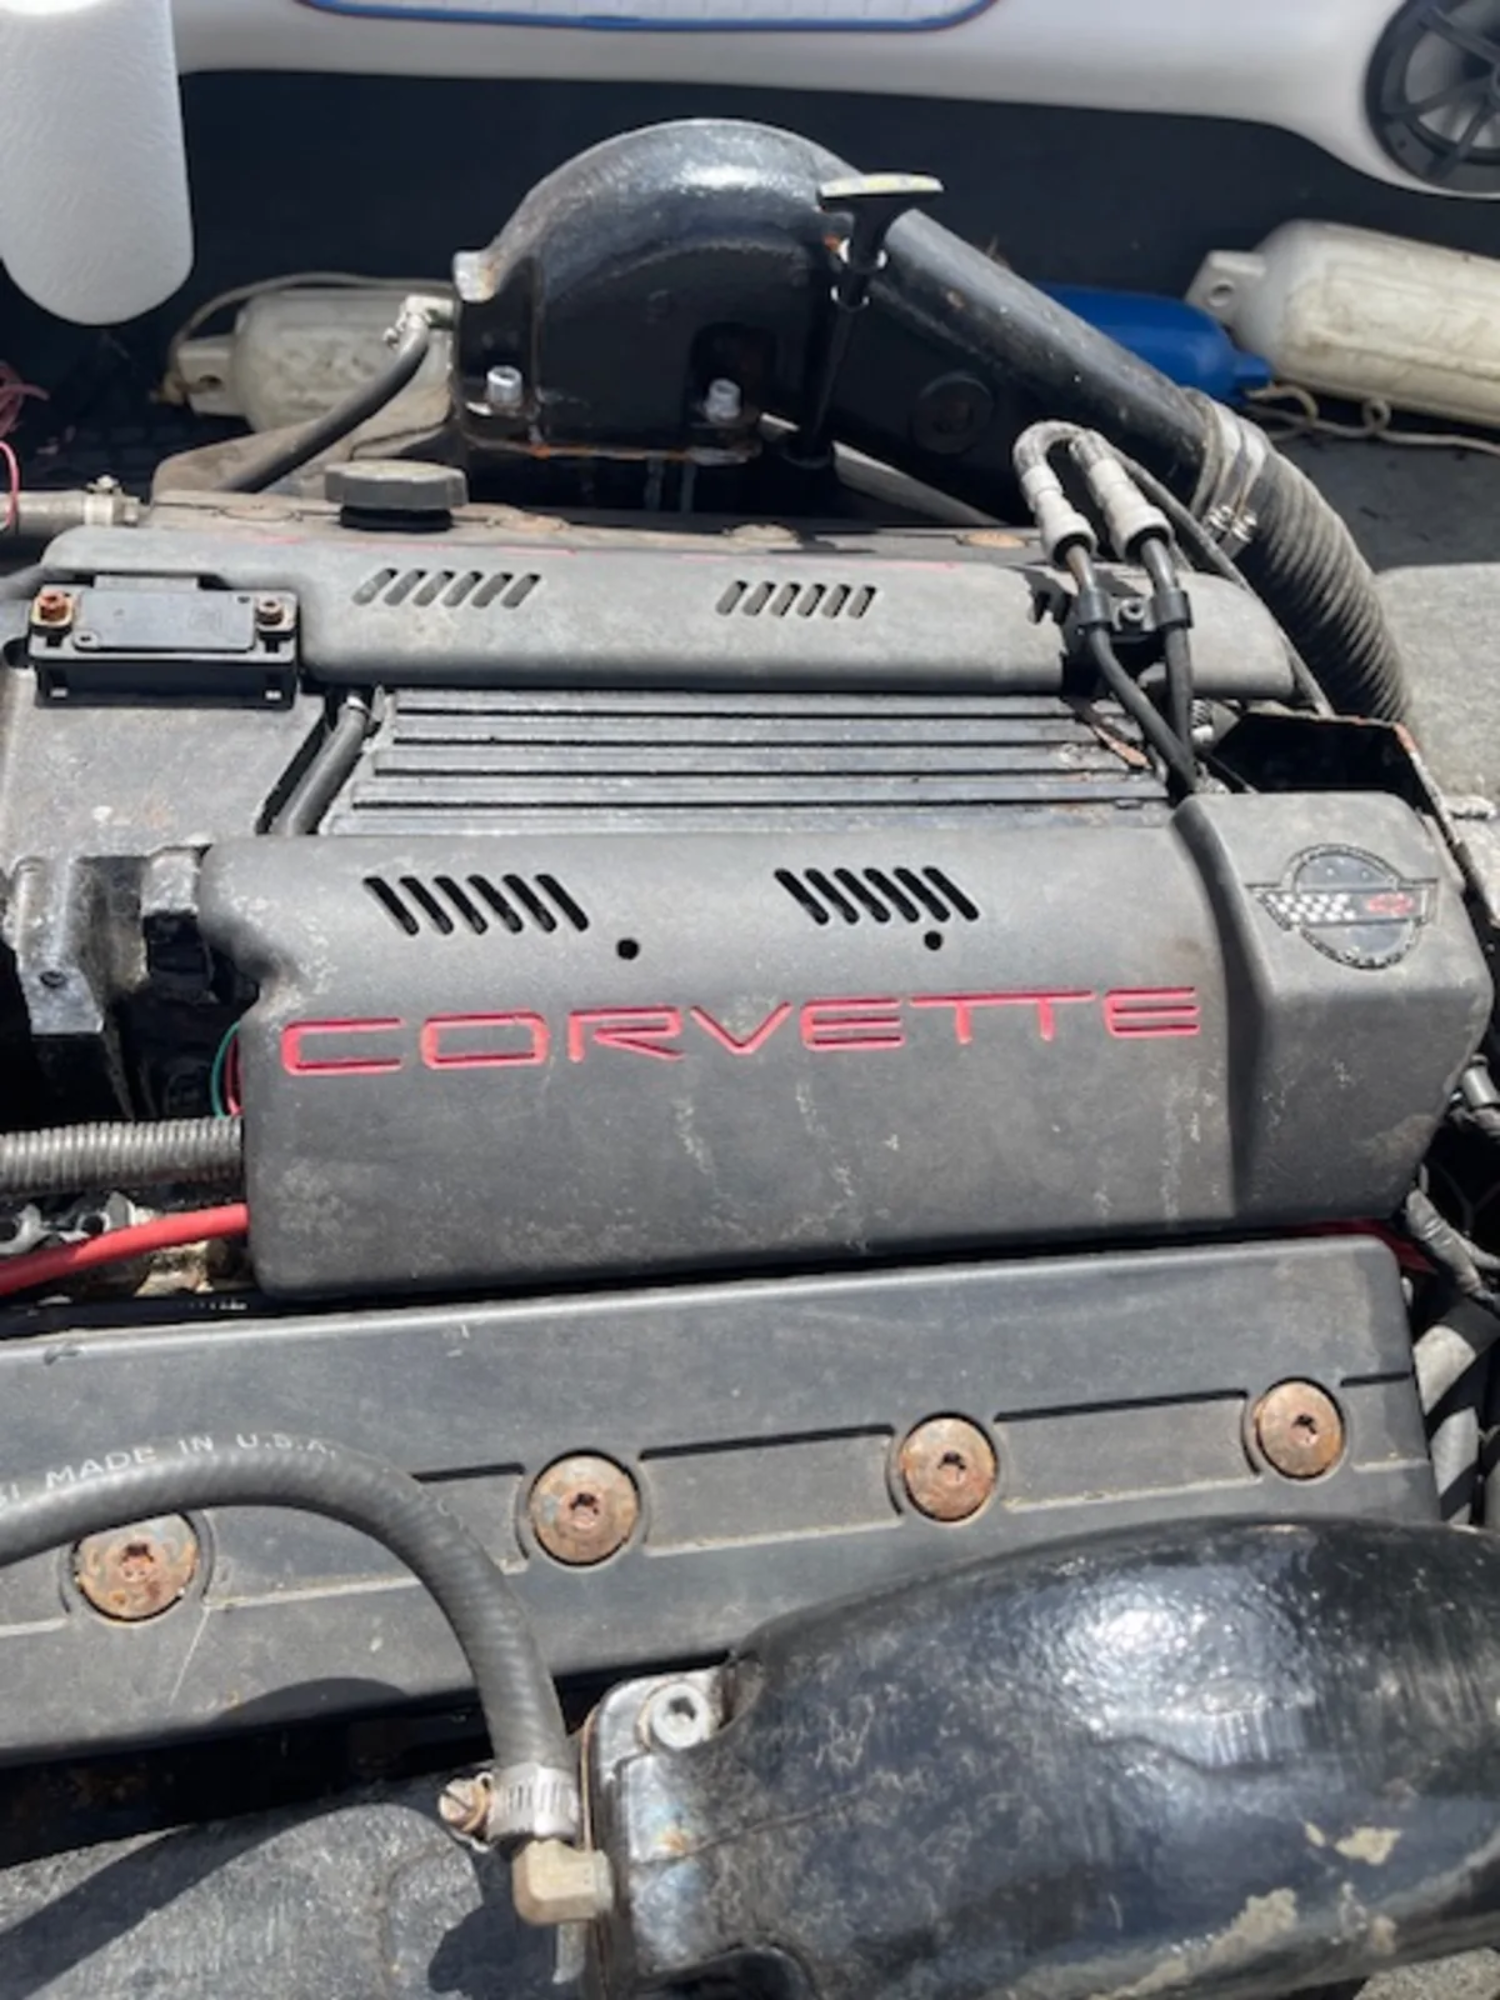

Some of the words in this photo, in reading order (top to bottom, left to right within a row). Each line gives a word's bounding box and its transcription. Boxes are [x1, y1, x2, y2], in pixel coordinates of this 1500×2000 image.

[281, 986, 1201, 1076] CORVETTE
[46, 1445, 157, 1489] MADE
[178, 1435, 214, 1455] IN
